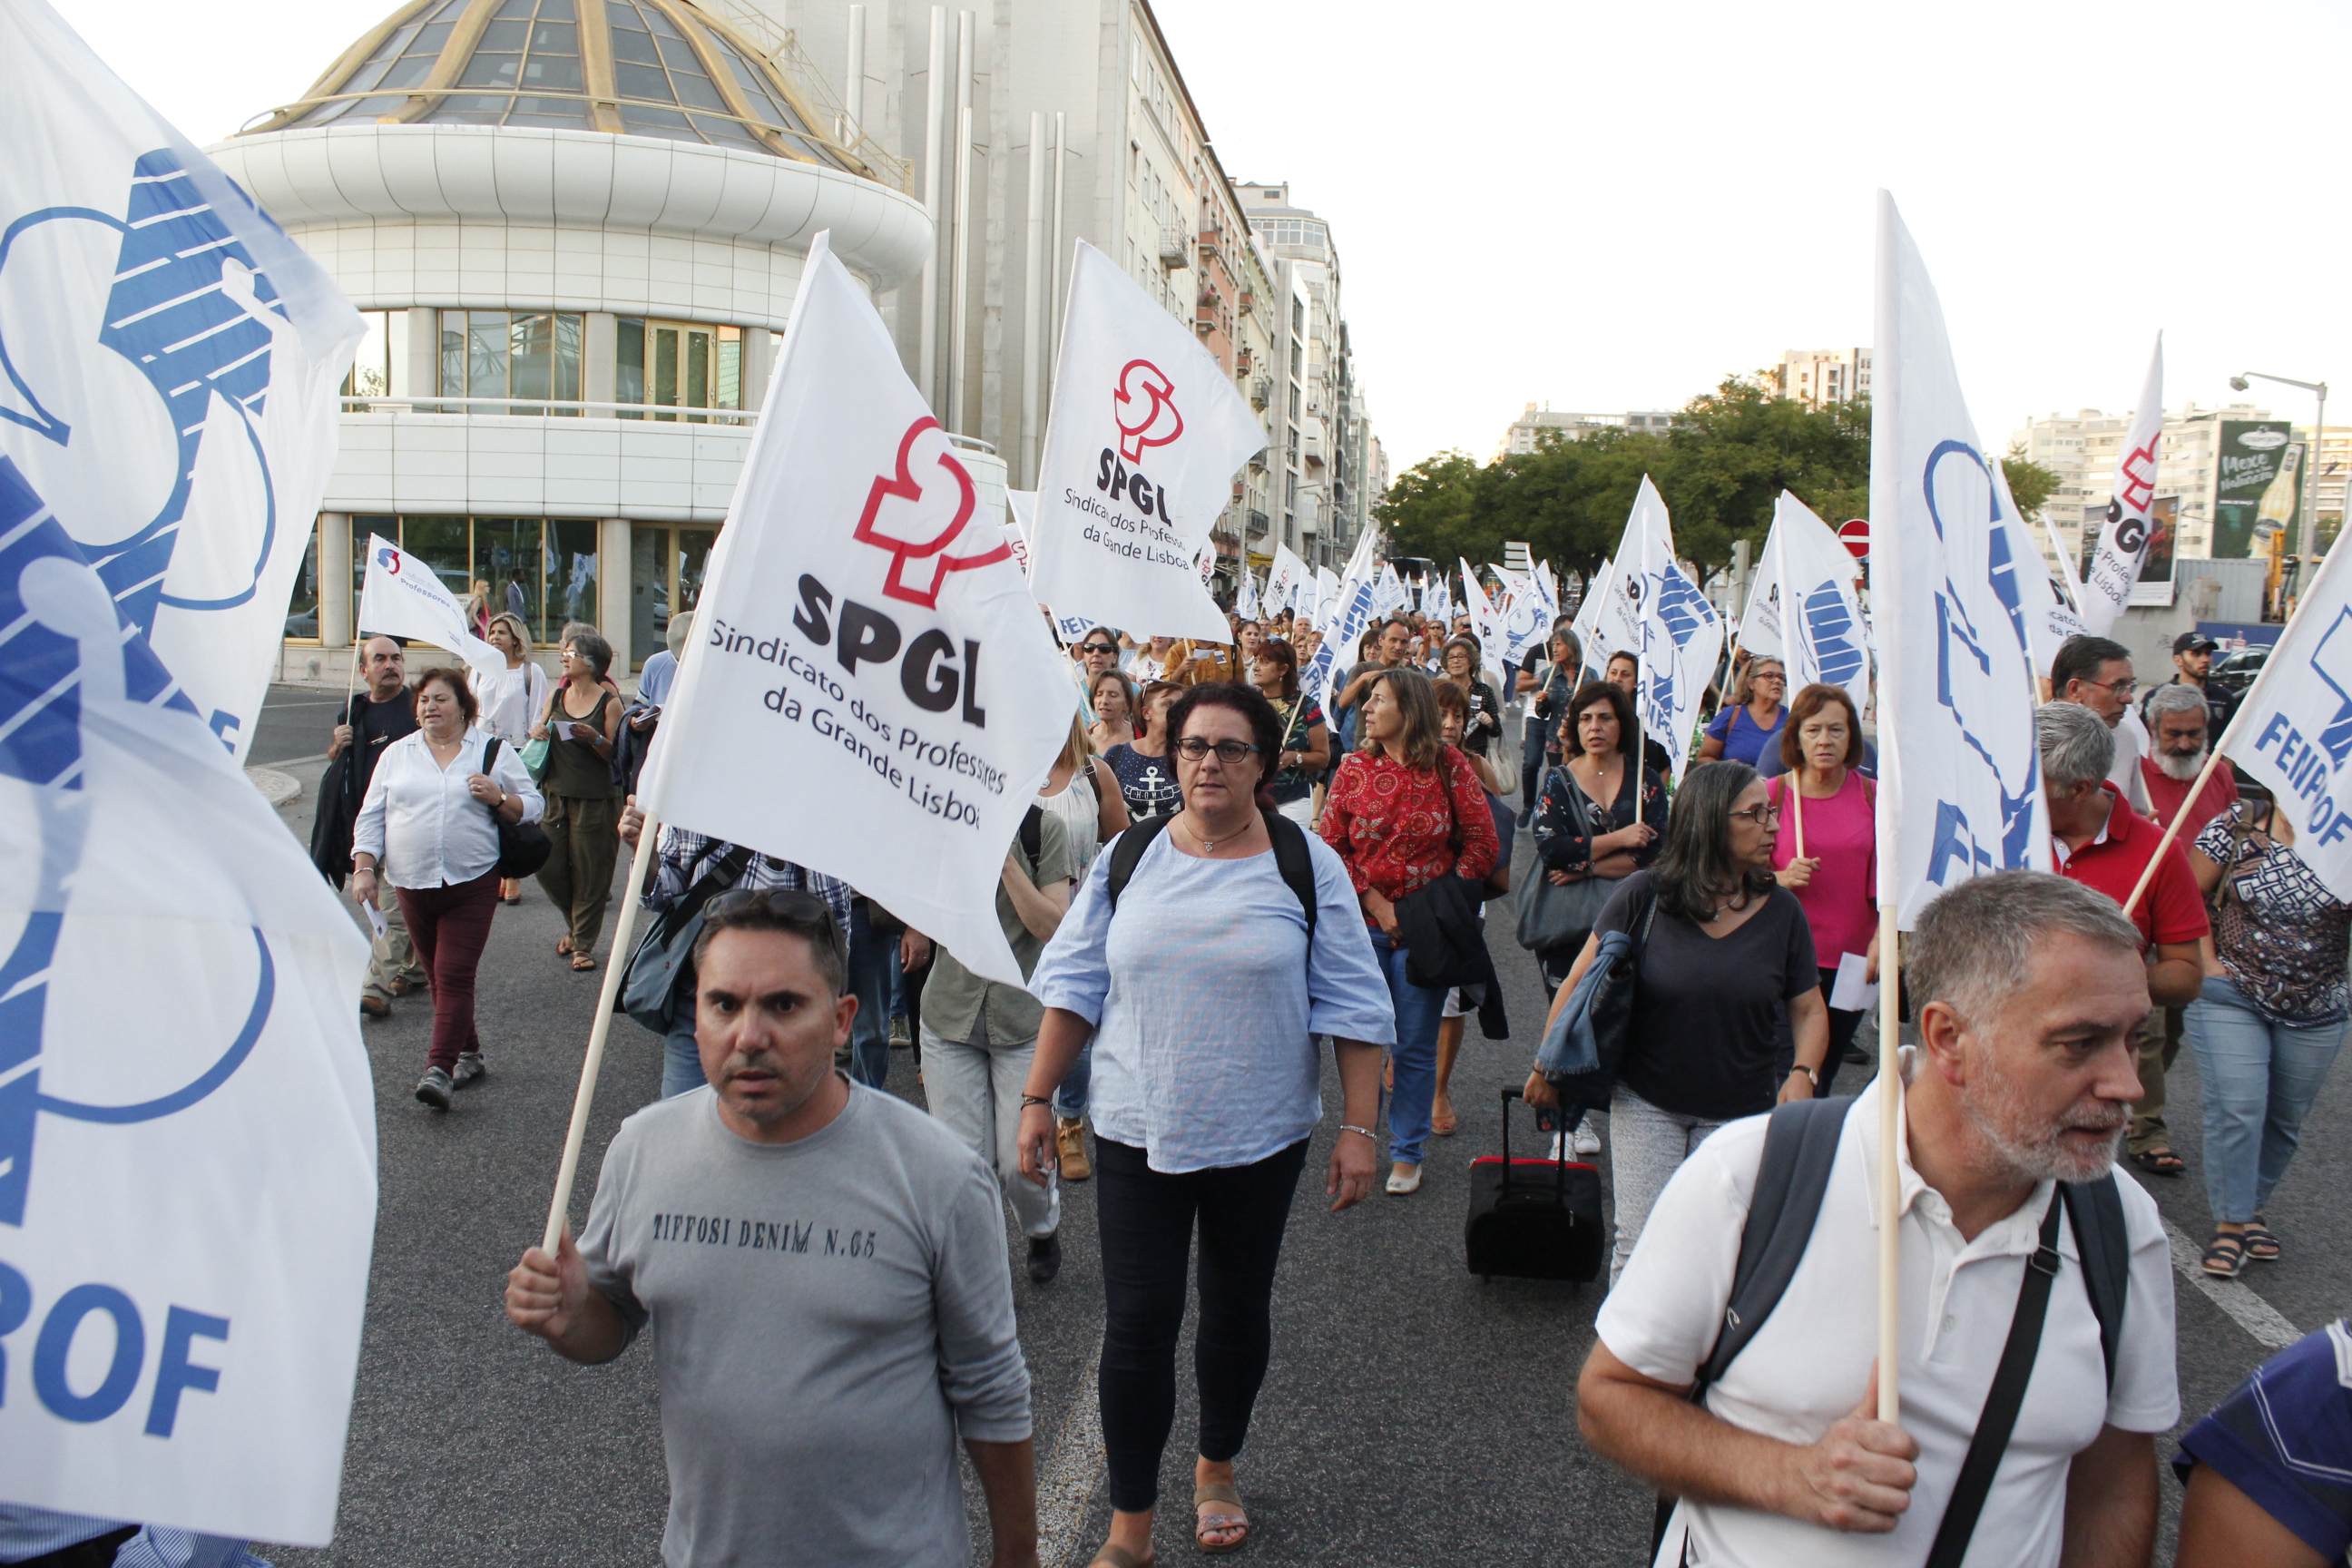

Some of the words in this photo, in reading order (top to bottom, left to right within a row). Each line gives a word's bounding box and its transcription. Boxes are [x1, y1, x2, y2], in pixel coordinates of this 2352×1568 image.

[1096, 447, 1173, 528] SPGL
[1083, 524, 1101, 544] da
[1146, 545, 1190, 571] Lisboa
[1110, 513, 1135, 534] dos
[400, 577, 451, 608] Professores
[710, 619, 845, 702] Sindicato
[850, 699, 892, 742] dos
[792, 573, 986, 730] SPGL
[763, 686, 802, 723] da
[811, 708, 903, 789] Grande
[652, 1212, 730, 1247] TIFFOSI
[737, 1218, 814, 1255] DENIM
